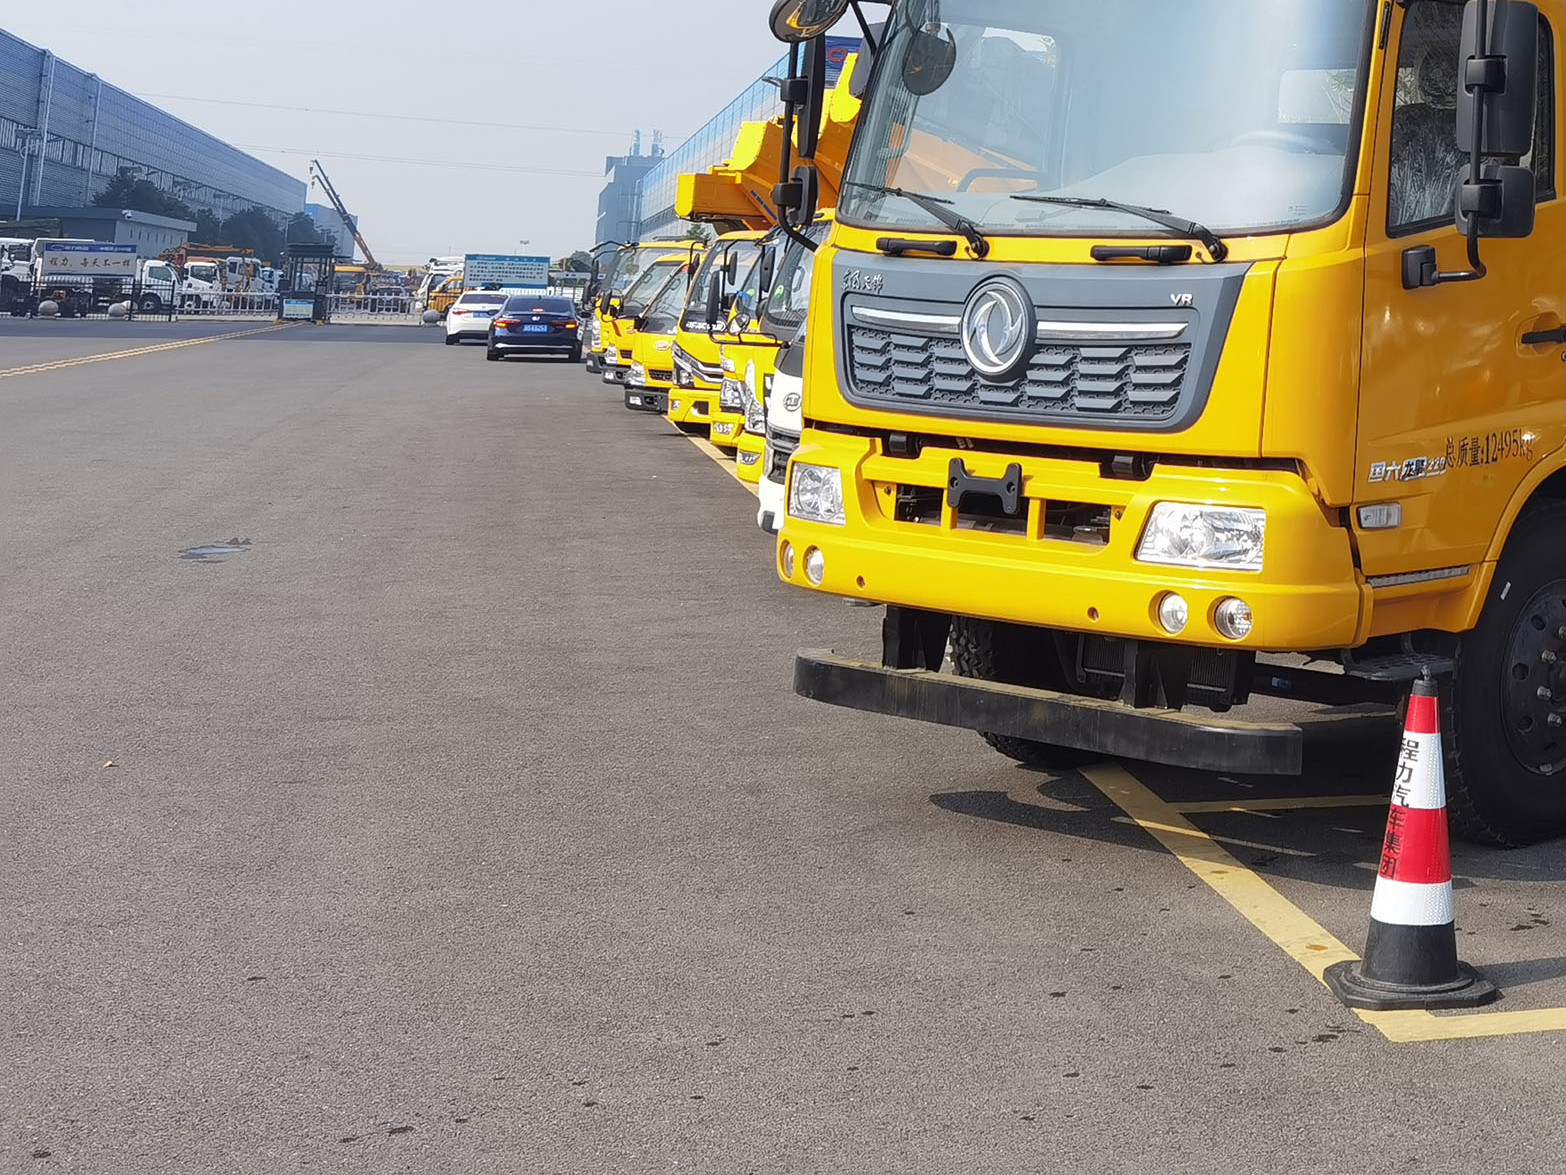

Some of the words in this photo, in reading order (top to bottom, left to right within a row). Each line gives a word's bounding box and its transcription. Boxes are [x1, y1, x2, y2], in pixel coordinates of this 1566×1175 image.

[1170, 293, 1193, 306] VR
[1380, 737, 1420, 879] 程力汽车集团
